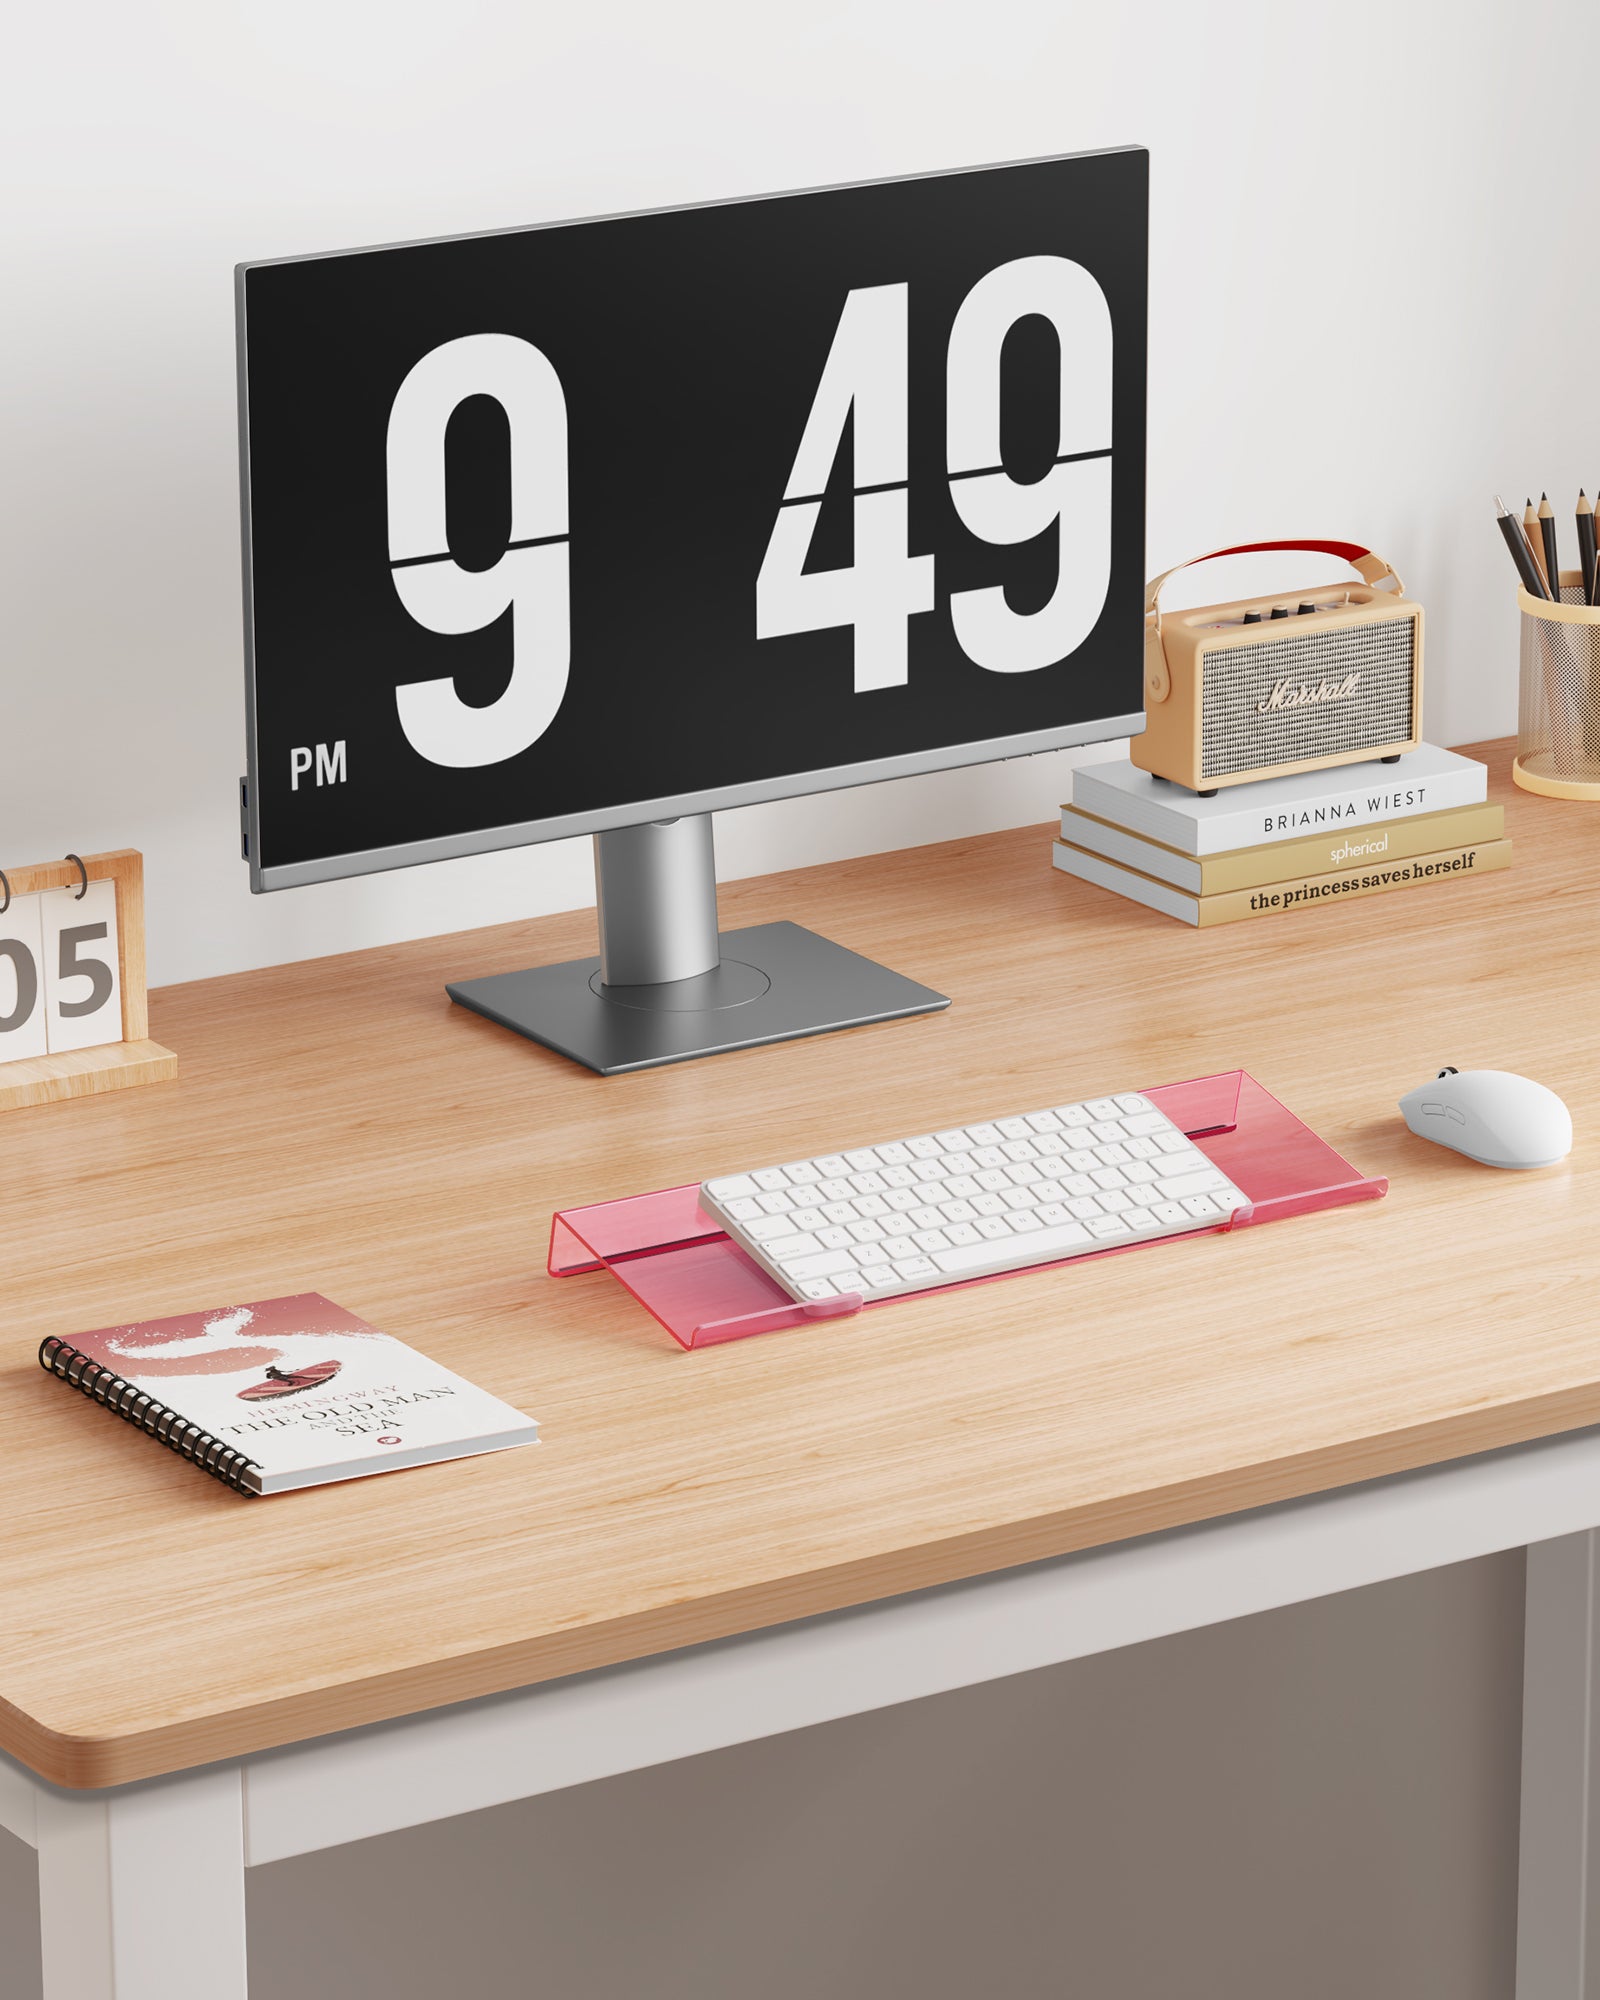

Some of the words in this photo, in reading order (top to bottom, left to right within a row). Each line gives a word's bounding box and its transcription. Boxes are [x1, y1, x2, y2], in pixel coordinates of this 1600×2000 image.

[386, 332, 571, 768] 9
[755, 254, 1114, 694] 49
[1257, 672, 1361, 712] Marshall
[290, 740, 347, 791] PM
[1264, 802, 1356, 832] BRIANNA
[1367, 788, 1426, 812] WIEST
[1330, 833, 1388, 864] spherical
[1250, 893, 1280, 910] the
[1283, 878, 1360, 908] princess
[1361, 868, 1411, 888] saves
[1412, 851, 1476, 879] herself
[220, 1416, 298, 1434] THE
[301, 1402, 374, 1421] OLD
[379, 1386, 456, 1407] MAN
[247, 1385, 399, 1417] HEMINGWAY
[309, 1416, 353, 1430] AND
[335, 1418, 403, 1437] SEA
